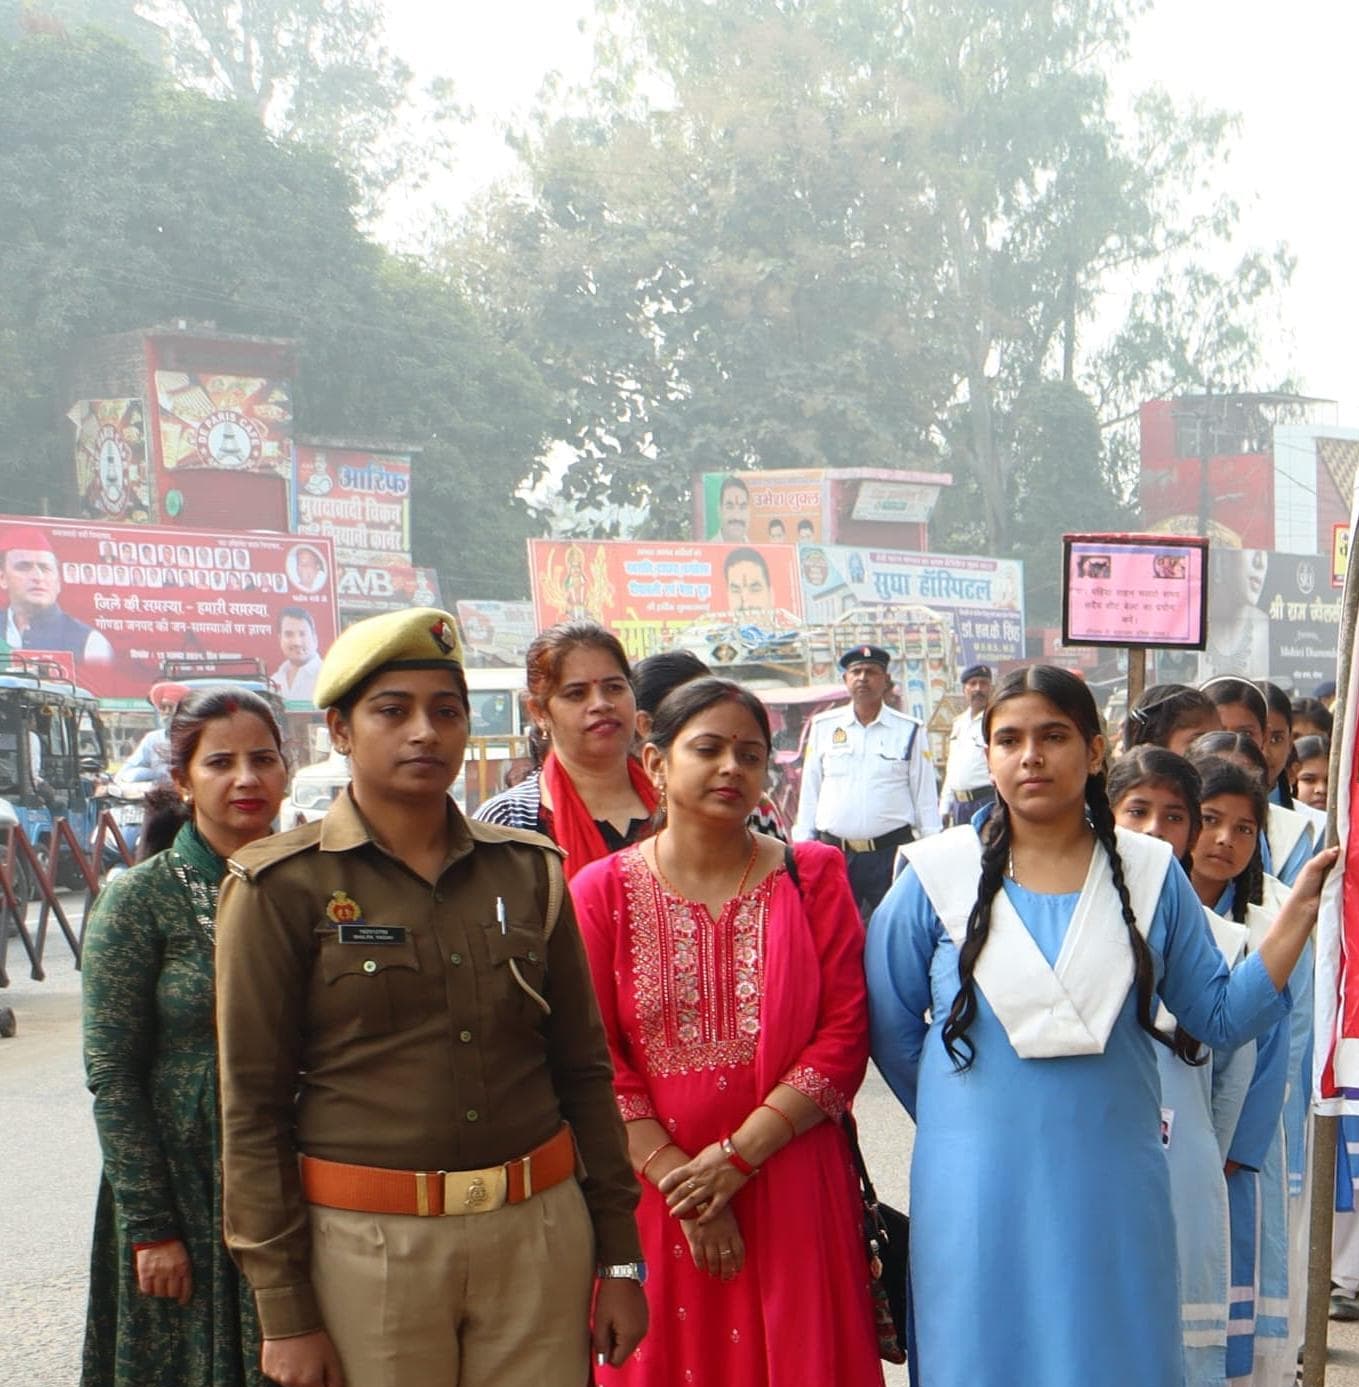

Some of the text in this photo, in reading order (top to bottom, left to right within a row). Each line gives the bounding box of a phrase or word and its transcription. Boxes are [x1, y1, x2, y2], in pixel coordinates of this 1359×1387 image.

[340, 464, 410, 496] आरिफ
[918, 569, 991, 602] हॉस्पिटल
[93, 592, 121, 611] जिले
[124, 593, 139, 613] की
[143, 600, 184, 613] समस्या
[197, 599, 227, 616] हमारी
[229, 602, 269, 617] समस्या
